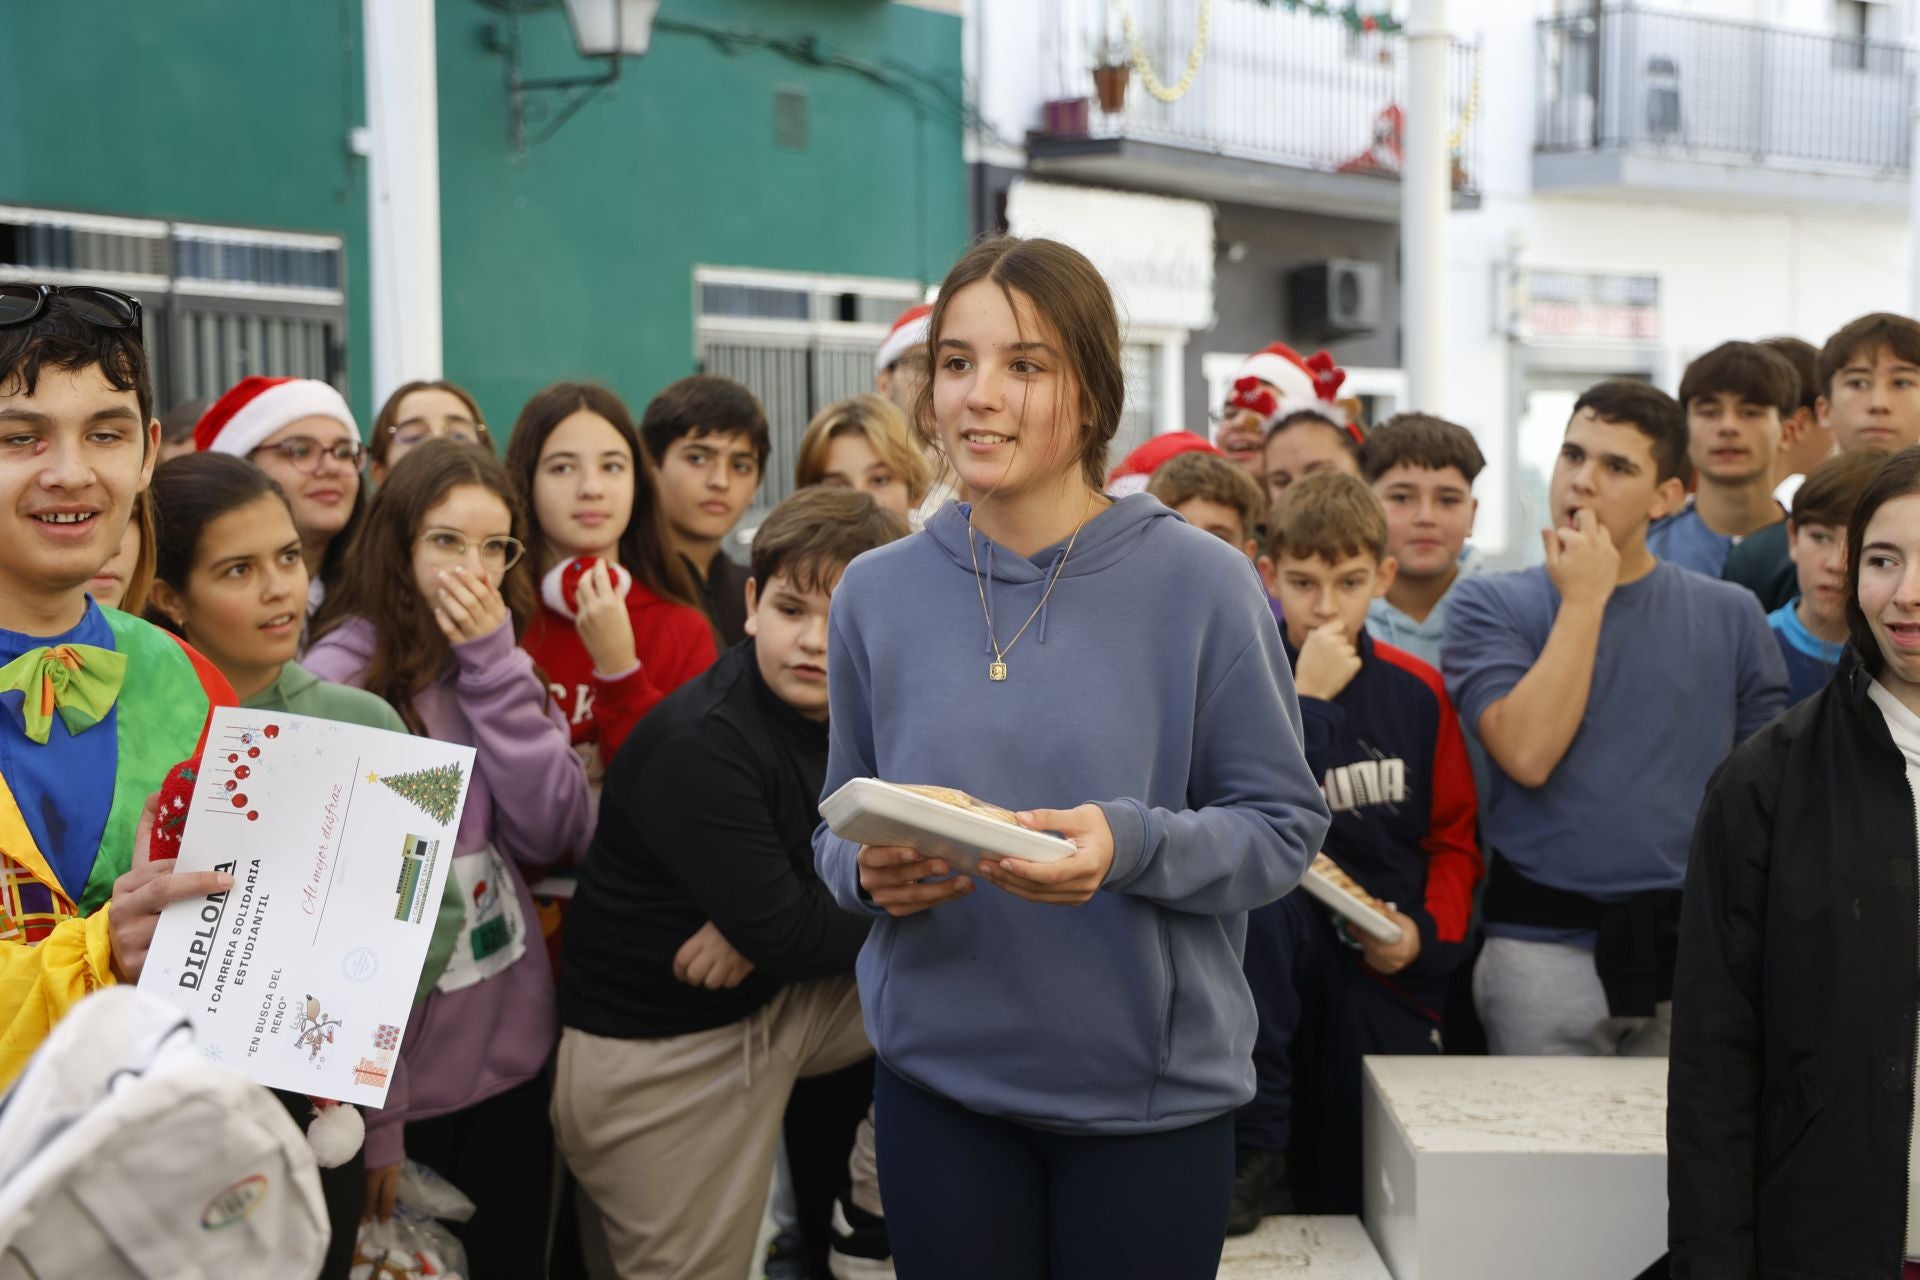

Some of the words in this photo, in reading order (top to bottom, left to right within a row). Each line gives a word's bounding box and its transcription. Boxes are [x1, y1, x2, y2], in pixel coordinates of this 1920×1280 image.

[1319, 758, 1405, 814] UMA
[302, 884, 318, 915] Al
[313, 844, 329, 884] mejor
[322, 783, 343, 840] disfraz
[232, 859, 261, 935] SOLIDARIA
[413, 887, 424, 915] CAMPOS
[211, 940, 238, 1003] CARRERA
[234, 893, 270, 986] ESTUDIANTIL
[207, 1006, 217, 1014] I
[255, 993, 274, 1034] BUSCA
[269, 968, 282, 989] DEL
